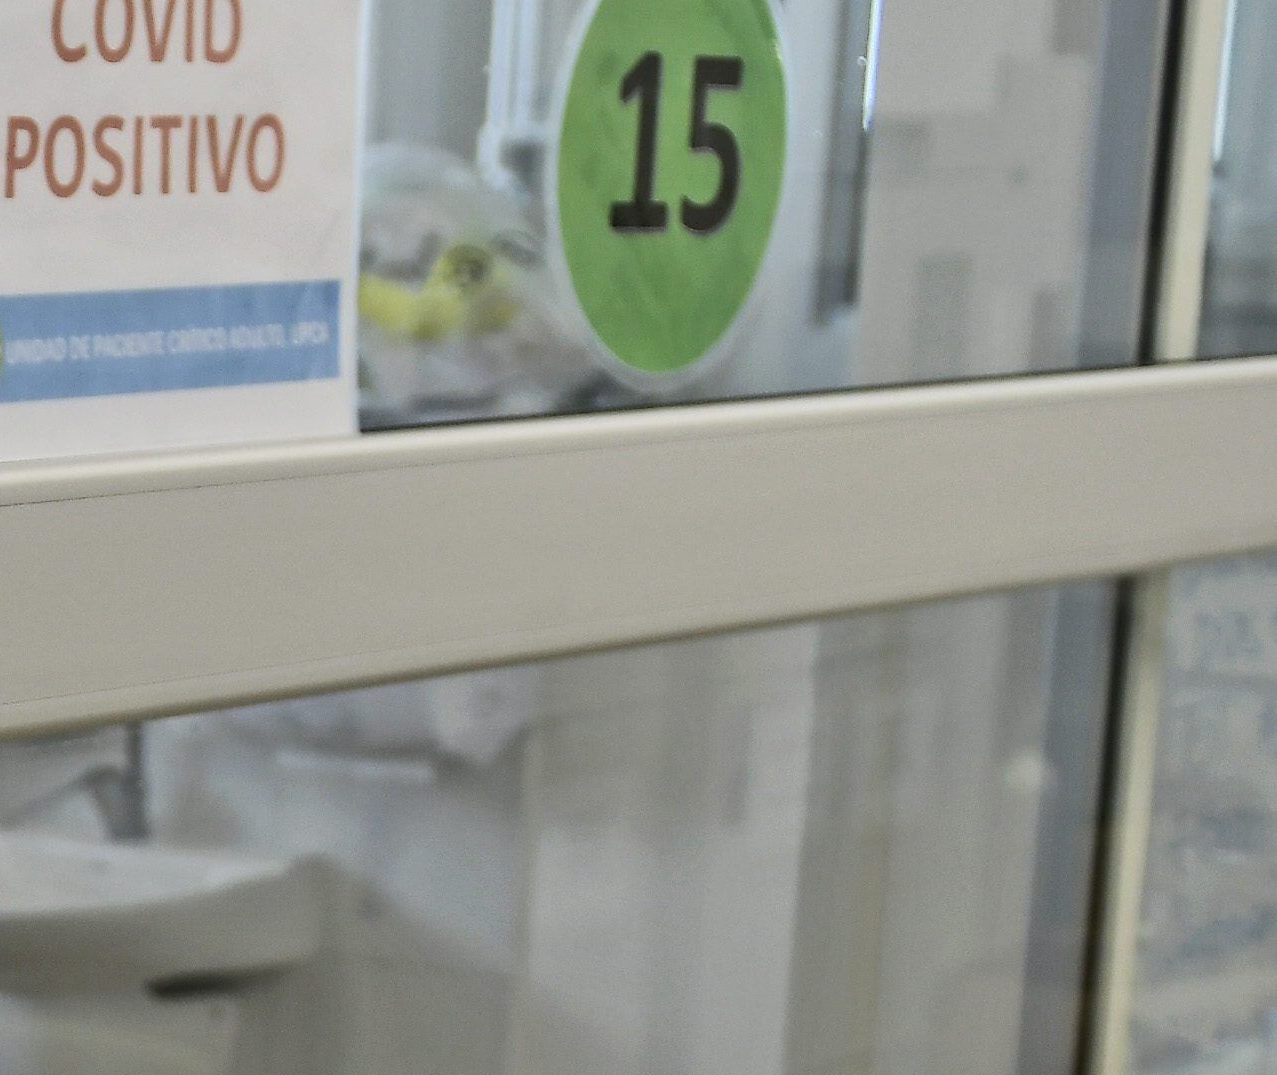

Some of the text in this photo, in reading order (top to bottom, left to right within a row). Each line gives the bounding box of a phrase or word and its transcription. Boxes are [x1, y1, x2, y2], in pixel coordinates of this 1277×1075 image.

[51, 0, 242, 64] COVID
[3, 112, 287, 200] POSITIVO
[607, 50, 745, 235] 15
